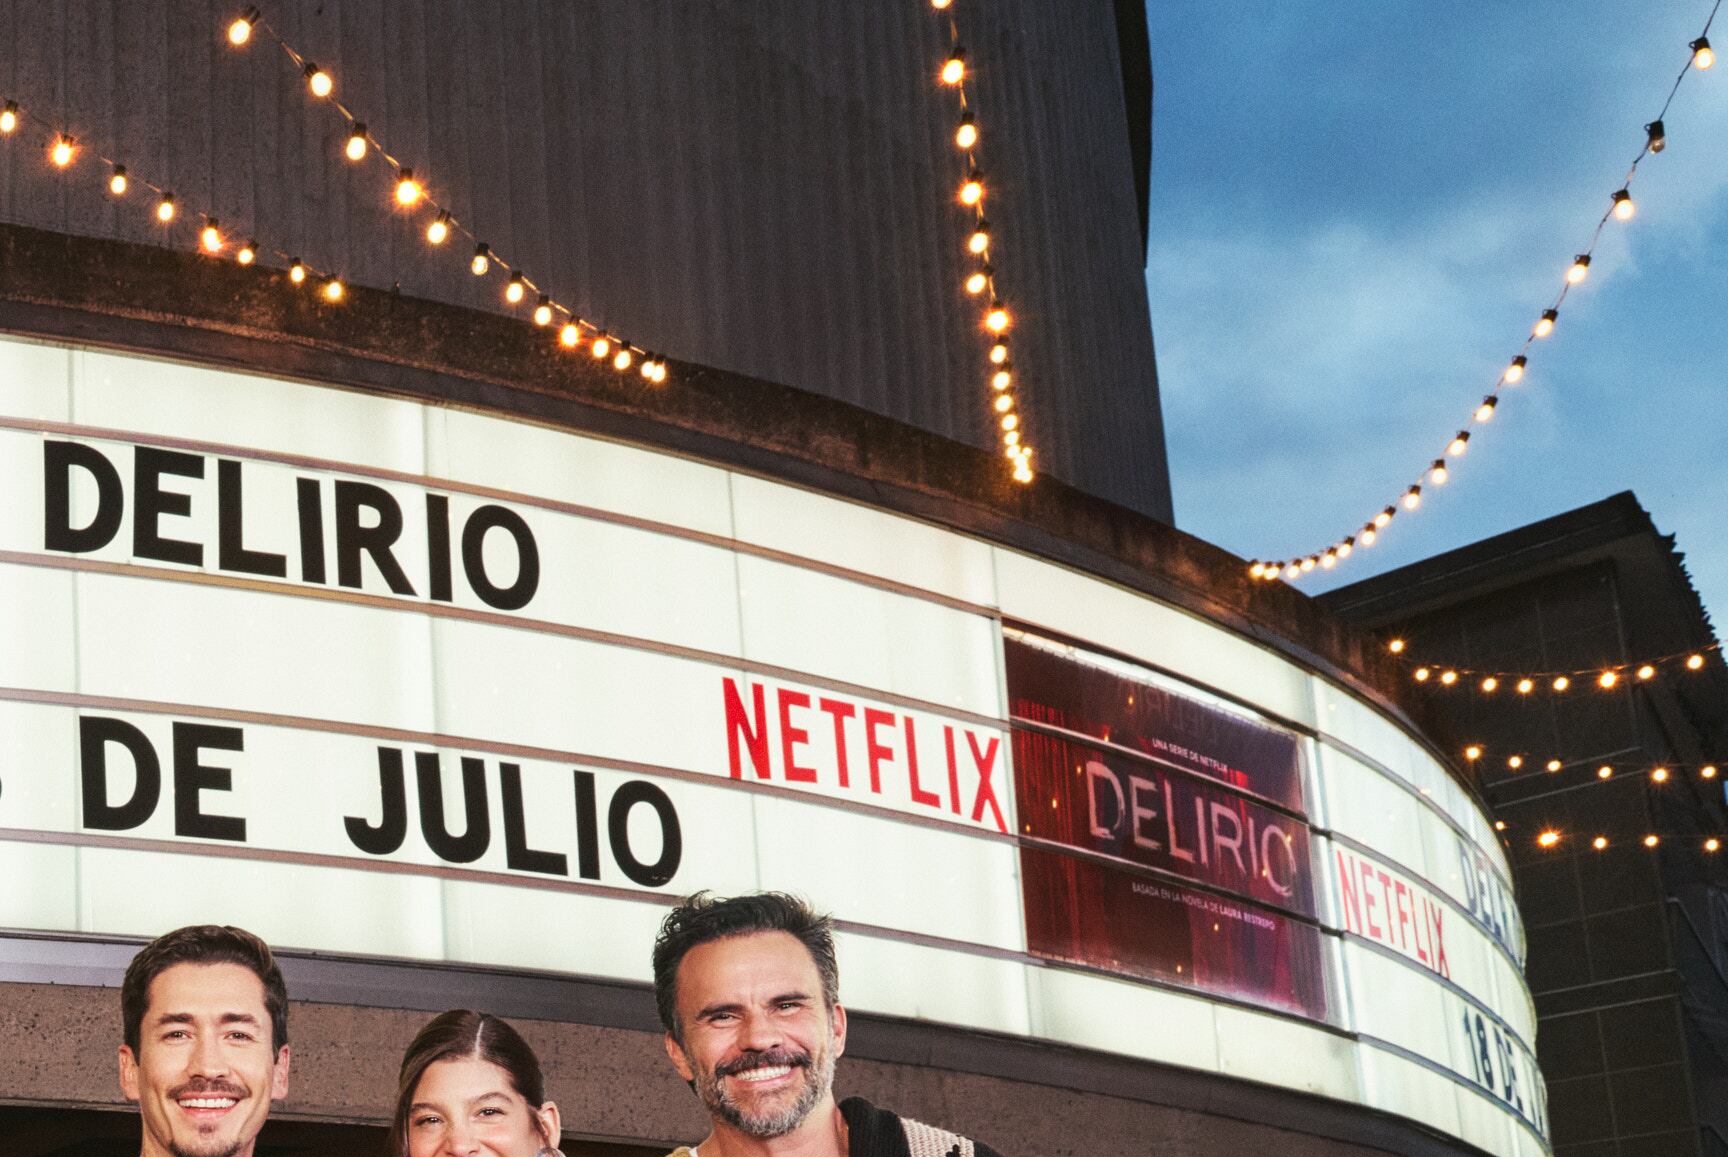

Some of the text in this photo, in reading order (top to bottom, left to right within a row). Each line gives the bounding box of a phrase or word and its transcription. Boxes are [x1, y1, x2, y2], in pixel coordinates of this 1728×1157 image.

[44, 439, 540, 611] DELIRIO
[79, 715, 246, 842] DE
[343, 746, 682, 888] JULIO
[722, 677, 1009, 834] NETFLIX
[1086, 760, 1296, 897] DELIRIO
[1336, 850, 1450, 979] NETFLIX
[1464, 1006, 1494, 1090] 18
